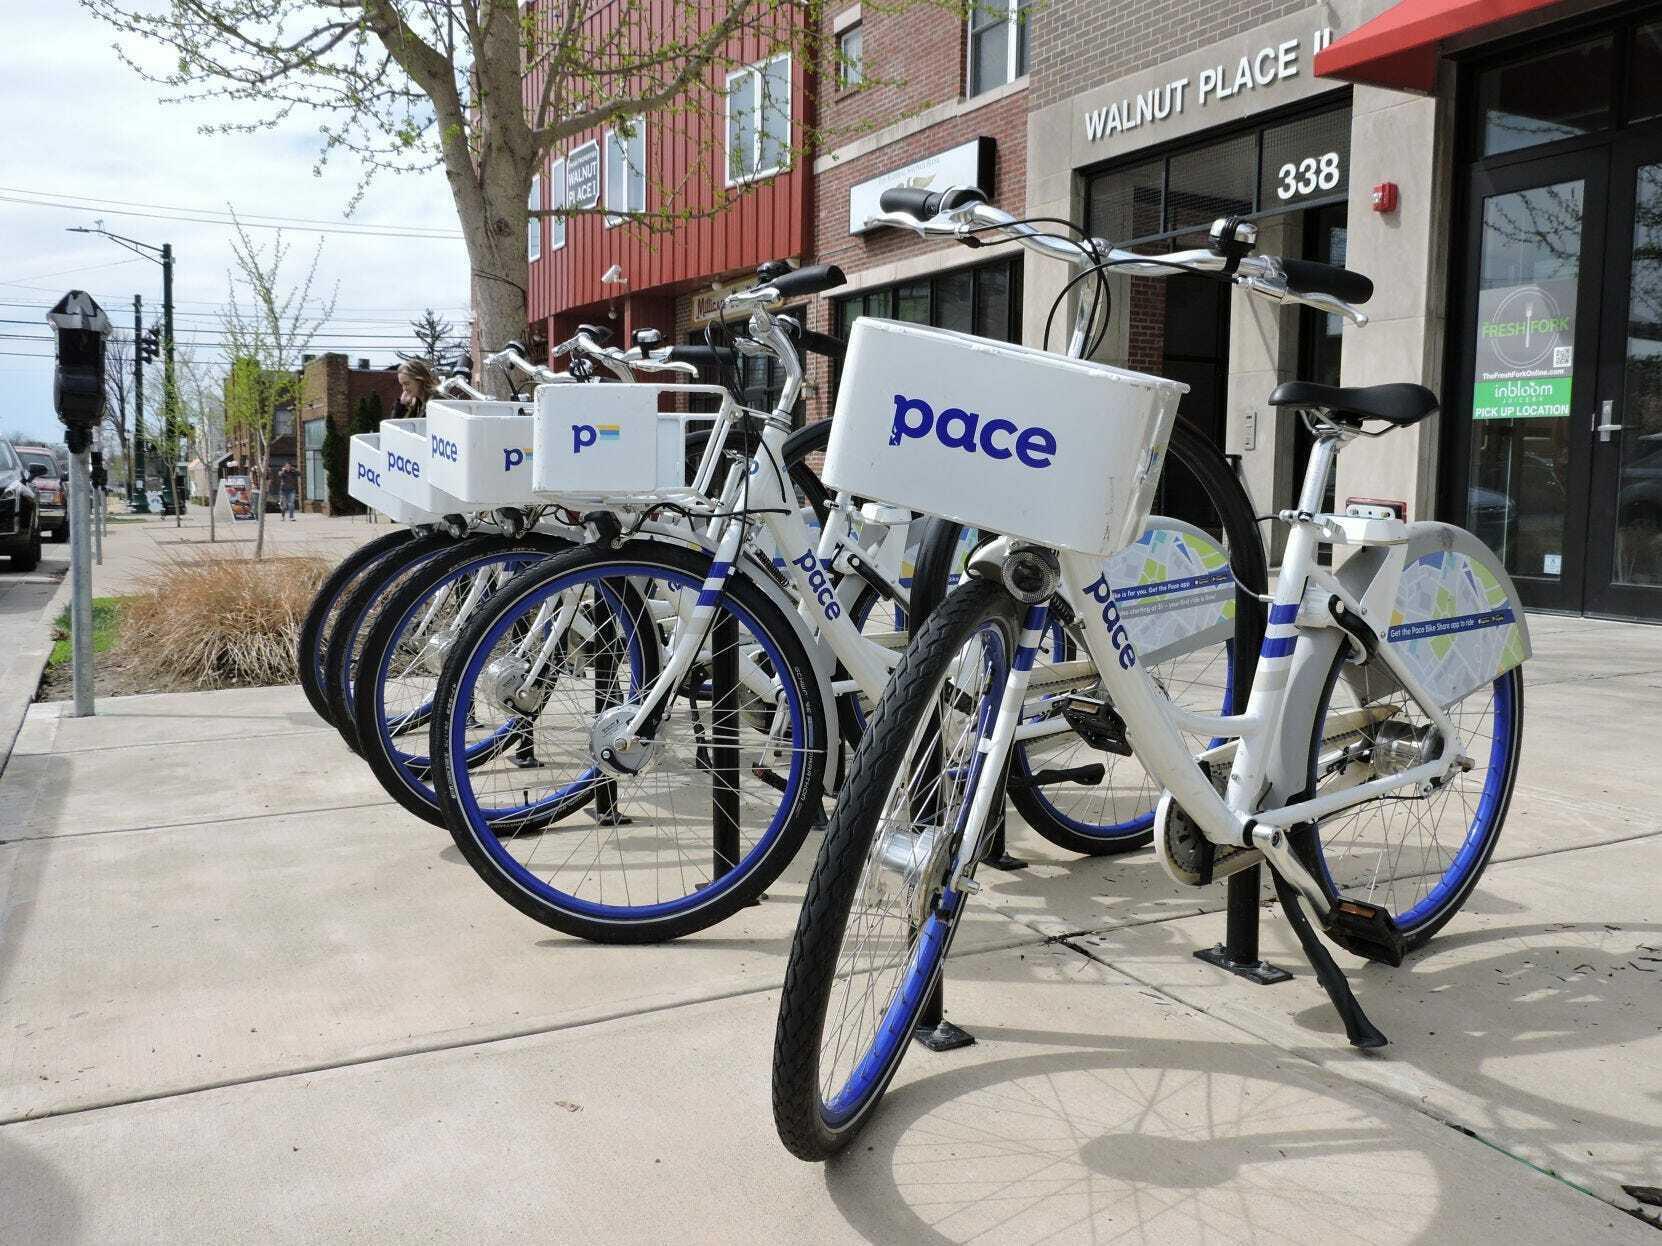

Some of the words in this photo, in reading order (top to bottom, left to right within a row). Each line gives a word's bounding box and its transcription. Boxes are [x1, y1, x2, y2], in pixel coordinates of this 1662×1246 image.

[1085, 78, 1189, 141] WALNUT
[1198, 38, 1298, 105] PLACE
[568, 162, 597, 186] WALNUT
[1277, 151, 1340, 200] 338
[1482, 320, 1525, 338] FRESH
[1530, 316, 1569, 334] FORK
[1494, 381, 1553, 398] inbloom
[1475, 406, 1498, 418] PICK
[1500, 405, 1516, 416] UP
[1516, 403, 1569, 415] LOCATION
[570, 424, 597, 454] p
[888, 394, 1057, 468] pace
[431, 432, 458, 463] pace
[387, 450, 420, 479] pace
[792, 548, 841, 621] pace
[1084, 571, 1136, 671] pace
[1390, 629, 1401, 638] Get
[1401, 627, 1412, 636] the
[1411, 625, 1425, 634] Pace
[1425, 624, 1437, 633] Bike
[1436, 622, 1450, 631] Share
[1450, 621, 1460, 630] app
[1465, 618, 1475, 627] ride
